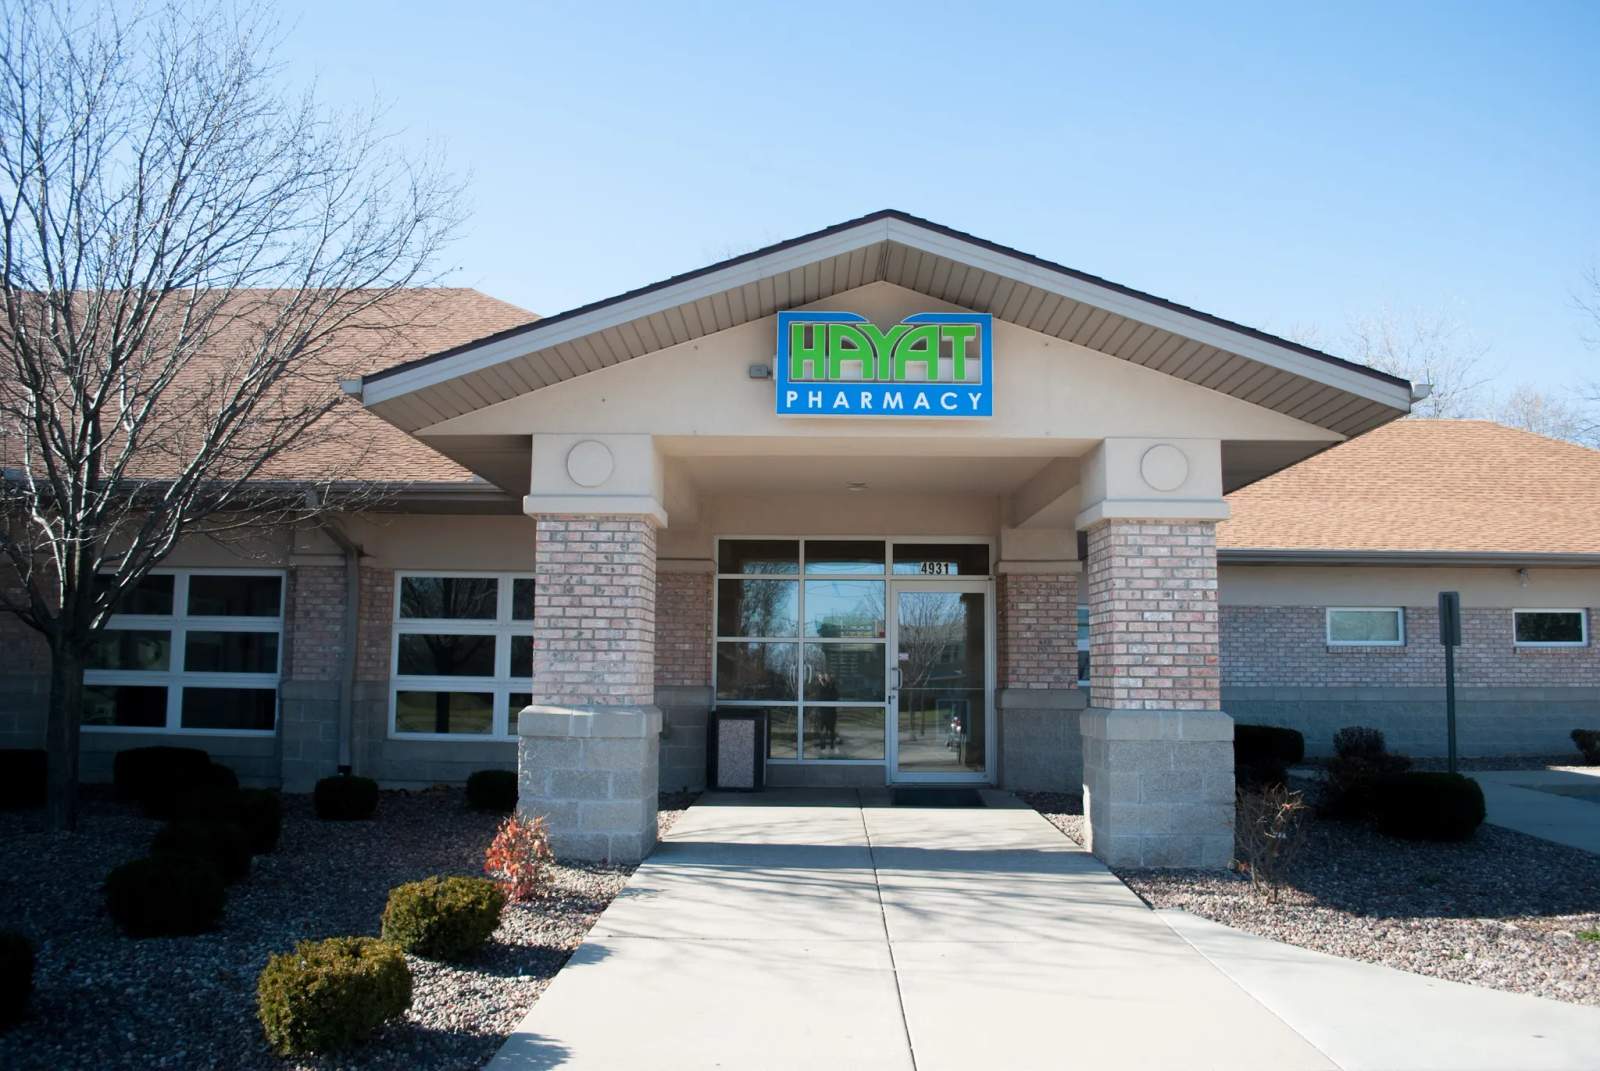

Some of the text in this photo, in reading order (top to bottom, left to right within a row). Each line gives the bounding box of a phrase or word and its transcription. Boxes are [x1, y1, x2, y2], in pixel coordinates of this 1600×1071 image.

[791, 323, 977, 380] HAYAT
[786, 390, 982, 410] PHARMACY
[920, 561, 949, 575] 4931
